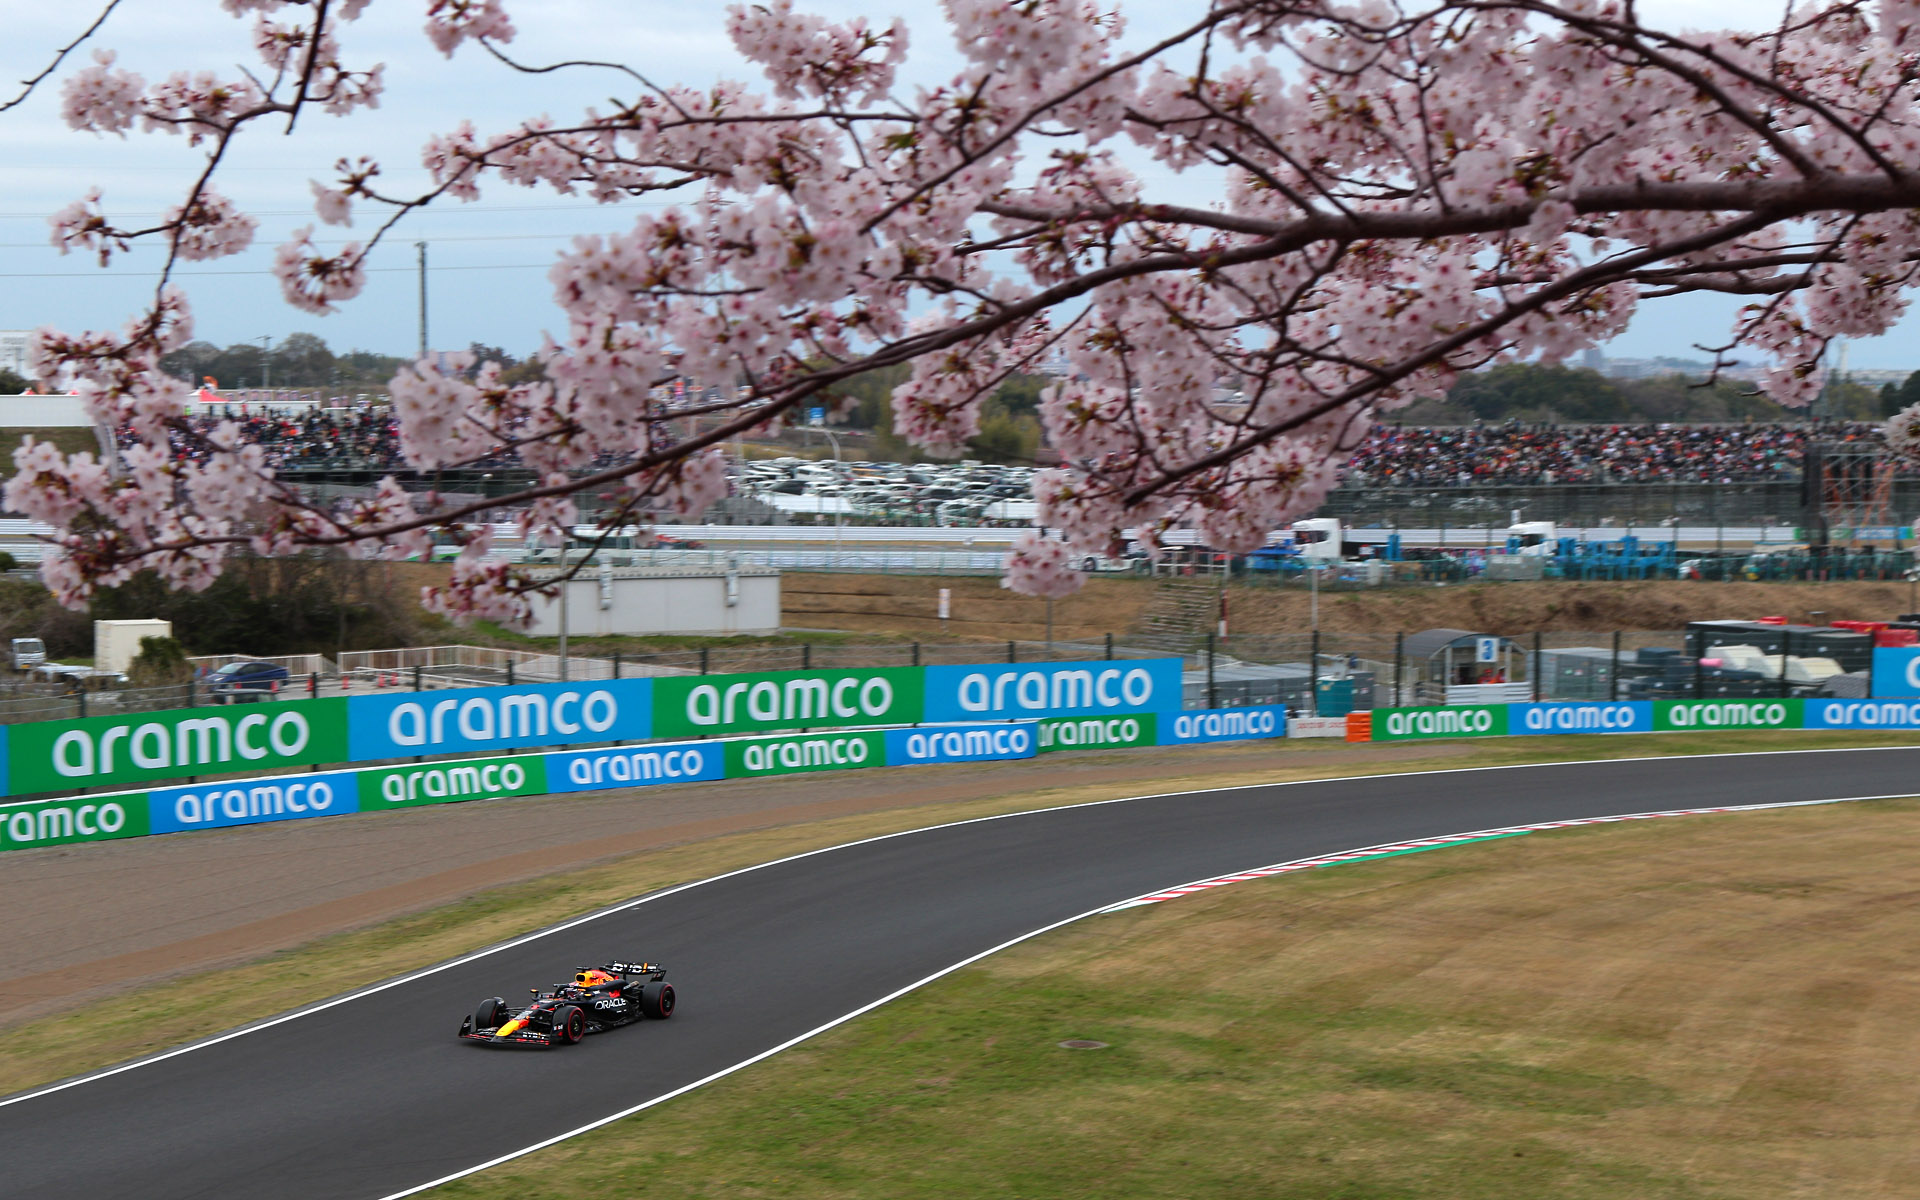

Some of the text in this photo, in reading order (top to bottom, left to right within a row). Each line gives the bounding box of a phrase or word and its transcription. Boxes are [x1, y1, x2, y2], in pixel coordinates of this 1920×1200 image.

[1482, 640, 1493, 660] 3
[686, 676, 893, 726] aramco
[958, 667, 1153, 712] aramco
[389, 690, 617, 746] aramco
[1174, 708, 1275, 739] aramco
[1386, 709, 1493, 735] aramco
[1525, 706, 1635, 731] aramco
[1669, 702, 1787, 727] aramco
[53, 711, 309, 777] aramco
[743, 737, 868, 771] aramco
[906, 725, 1030, 759] aramco
[382, 762, 525, 803] aramco
[569, 749, 703, 785] aramco
[175, 781, 333, 824] aramco
[595, 998, 627, 1009] ORACLE
